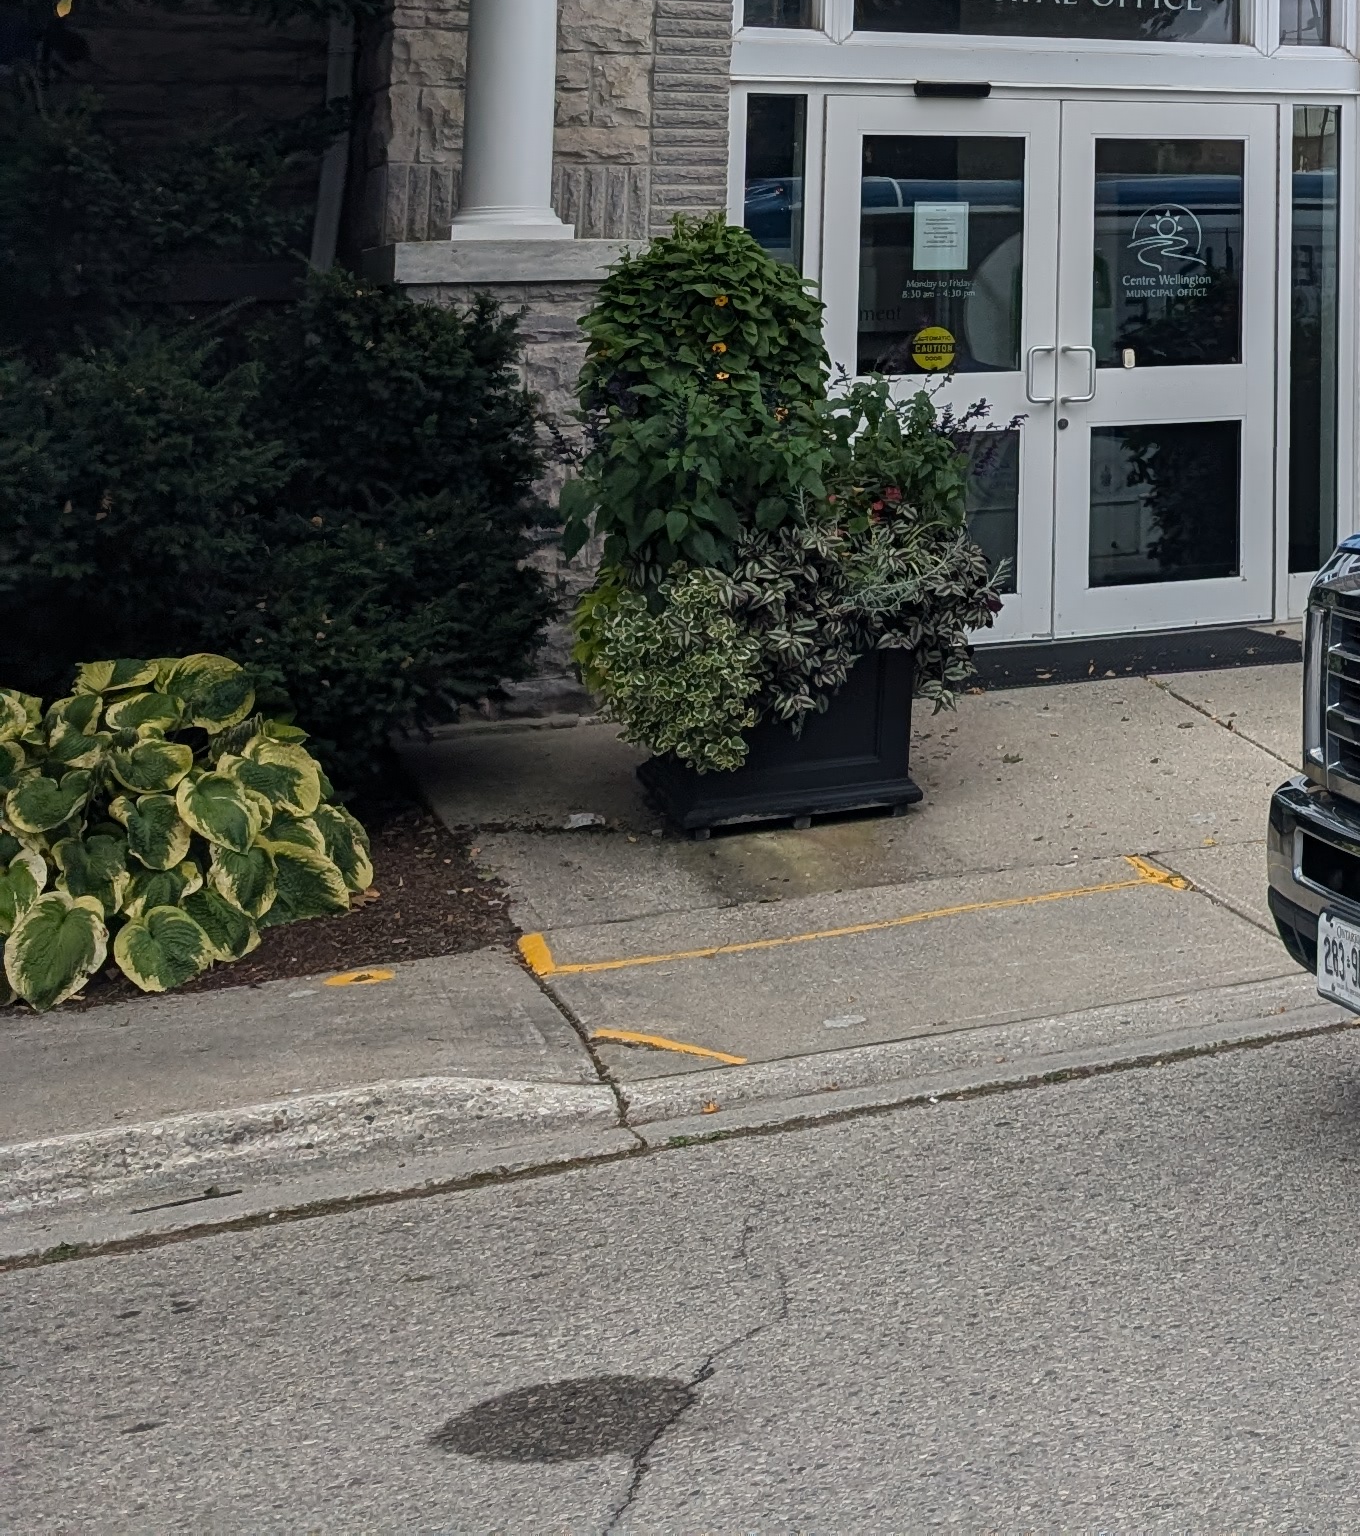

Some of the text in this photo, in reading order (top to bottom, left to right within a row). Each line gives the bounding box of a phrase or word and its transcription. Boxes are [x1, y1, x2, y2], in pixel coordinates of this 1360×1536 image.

[906, 279, 937, 291] Monday
[939, 280, 947, 288] to
[1122, 274, 1212, 288] Centre Wellington
[942, 289, 961, 298] 4:30
[1125, 288, 1208, 298] MUNICIPAL OFFICE
[914, 344, 953, 353] CAUTION
